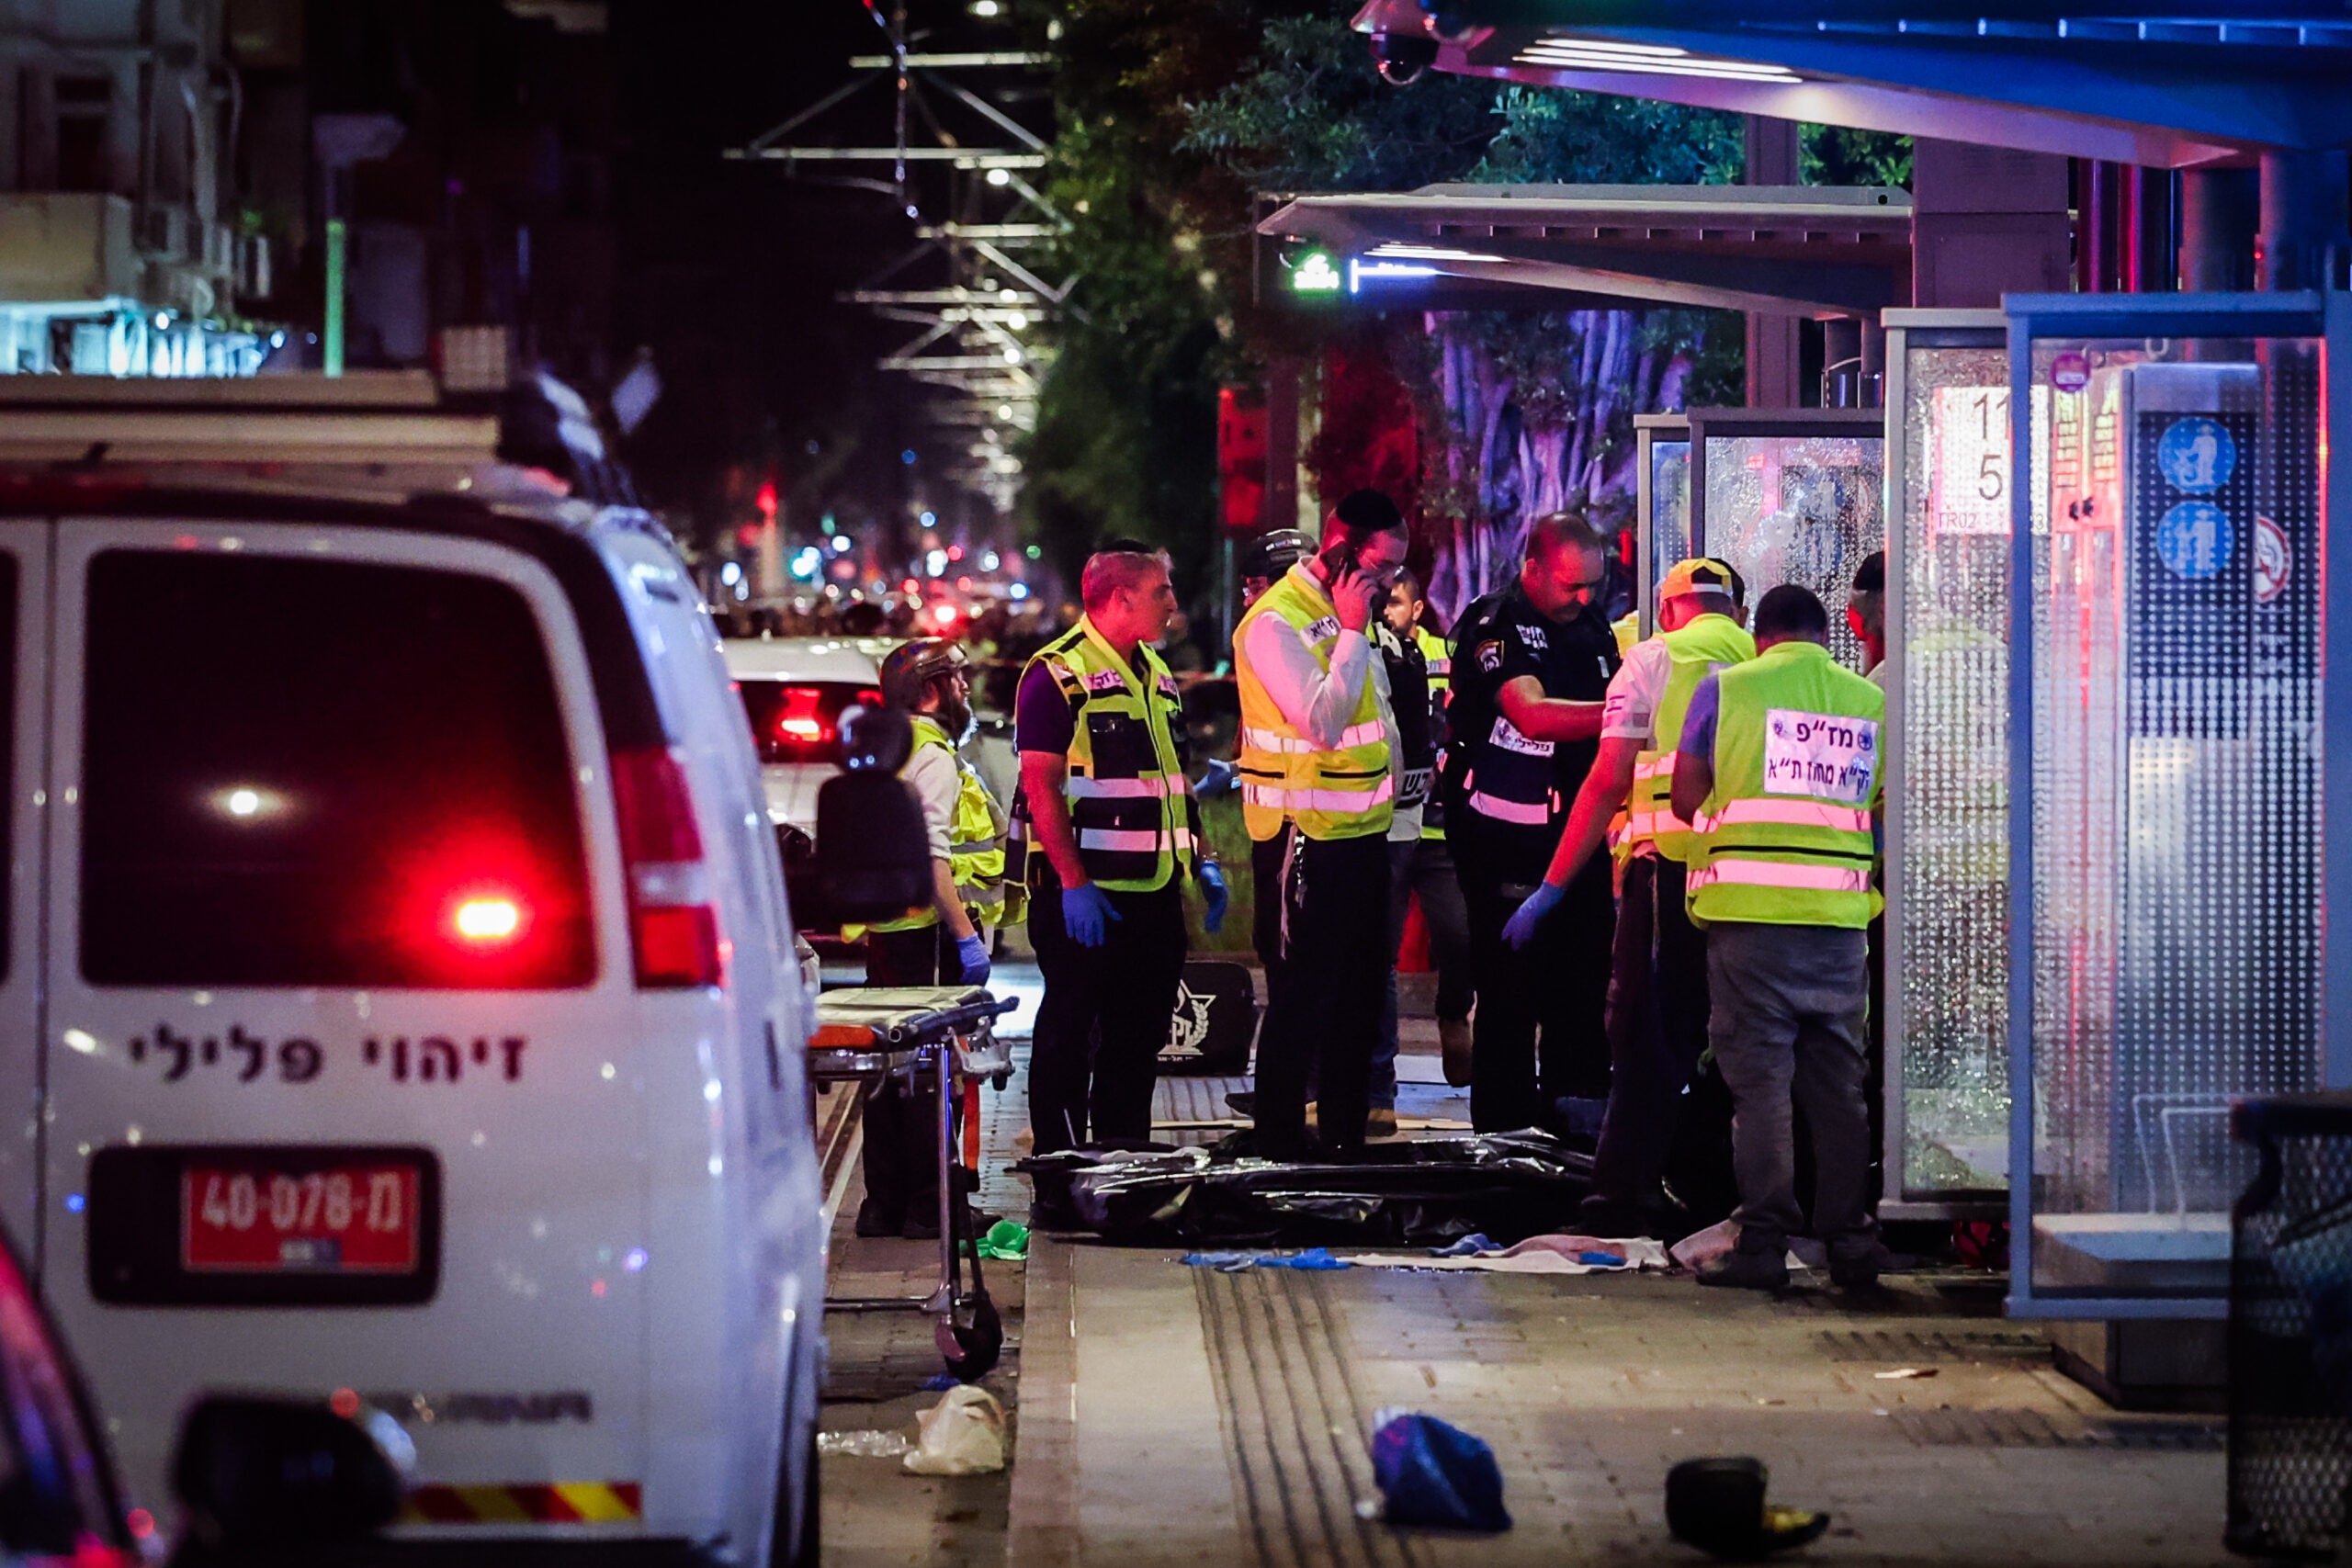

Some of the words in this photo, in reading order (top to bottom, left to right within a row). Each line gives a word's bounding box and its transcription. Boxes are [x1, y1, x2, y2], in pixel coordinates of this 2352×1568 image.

[1978, 454, 2004, 502] 5
[127, 1021, 323, 1085] פלילי
[363, 1034, 526, 1084] זיהוי
